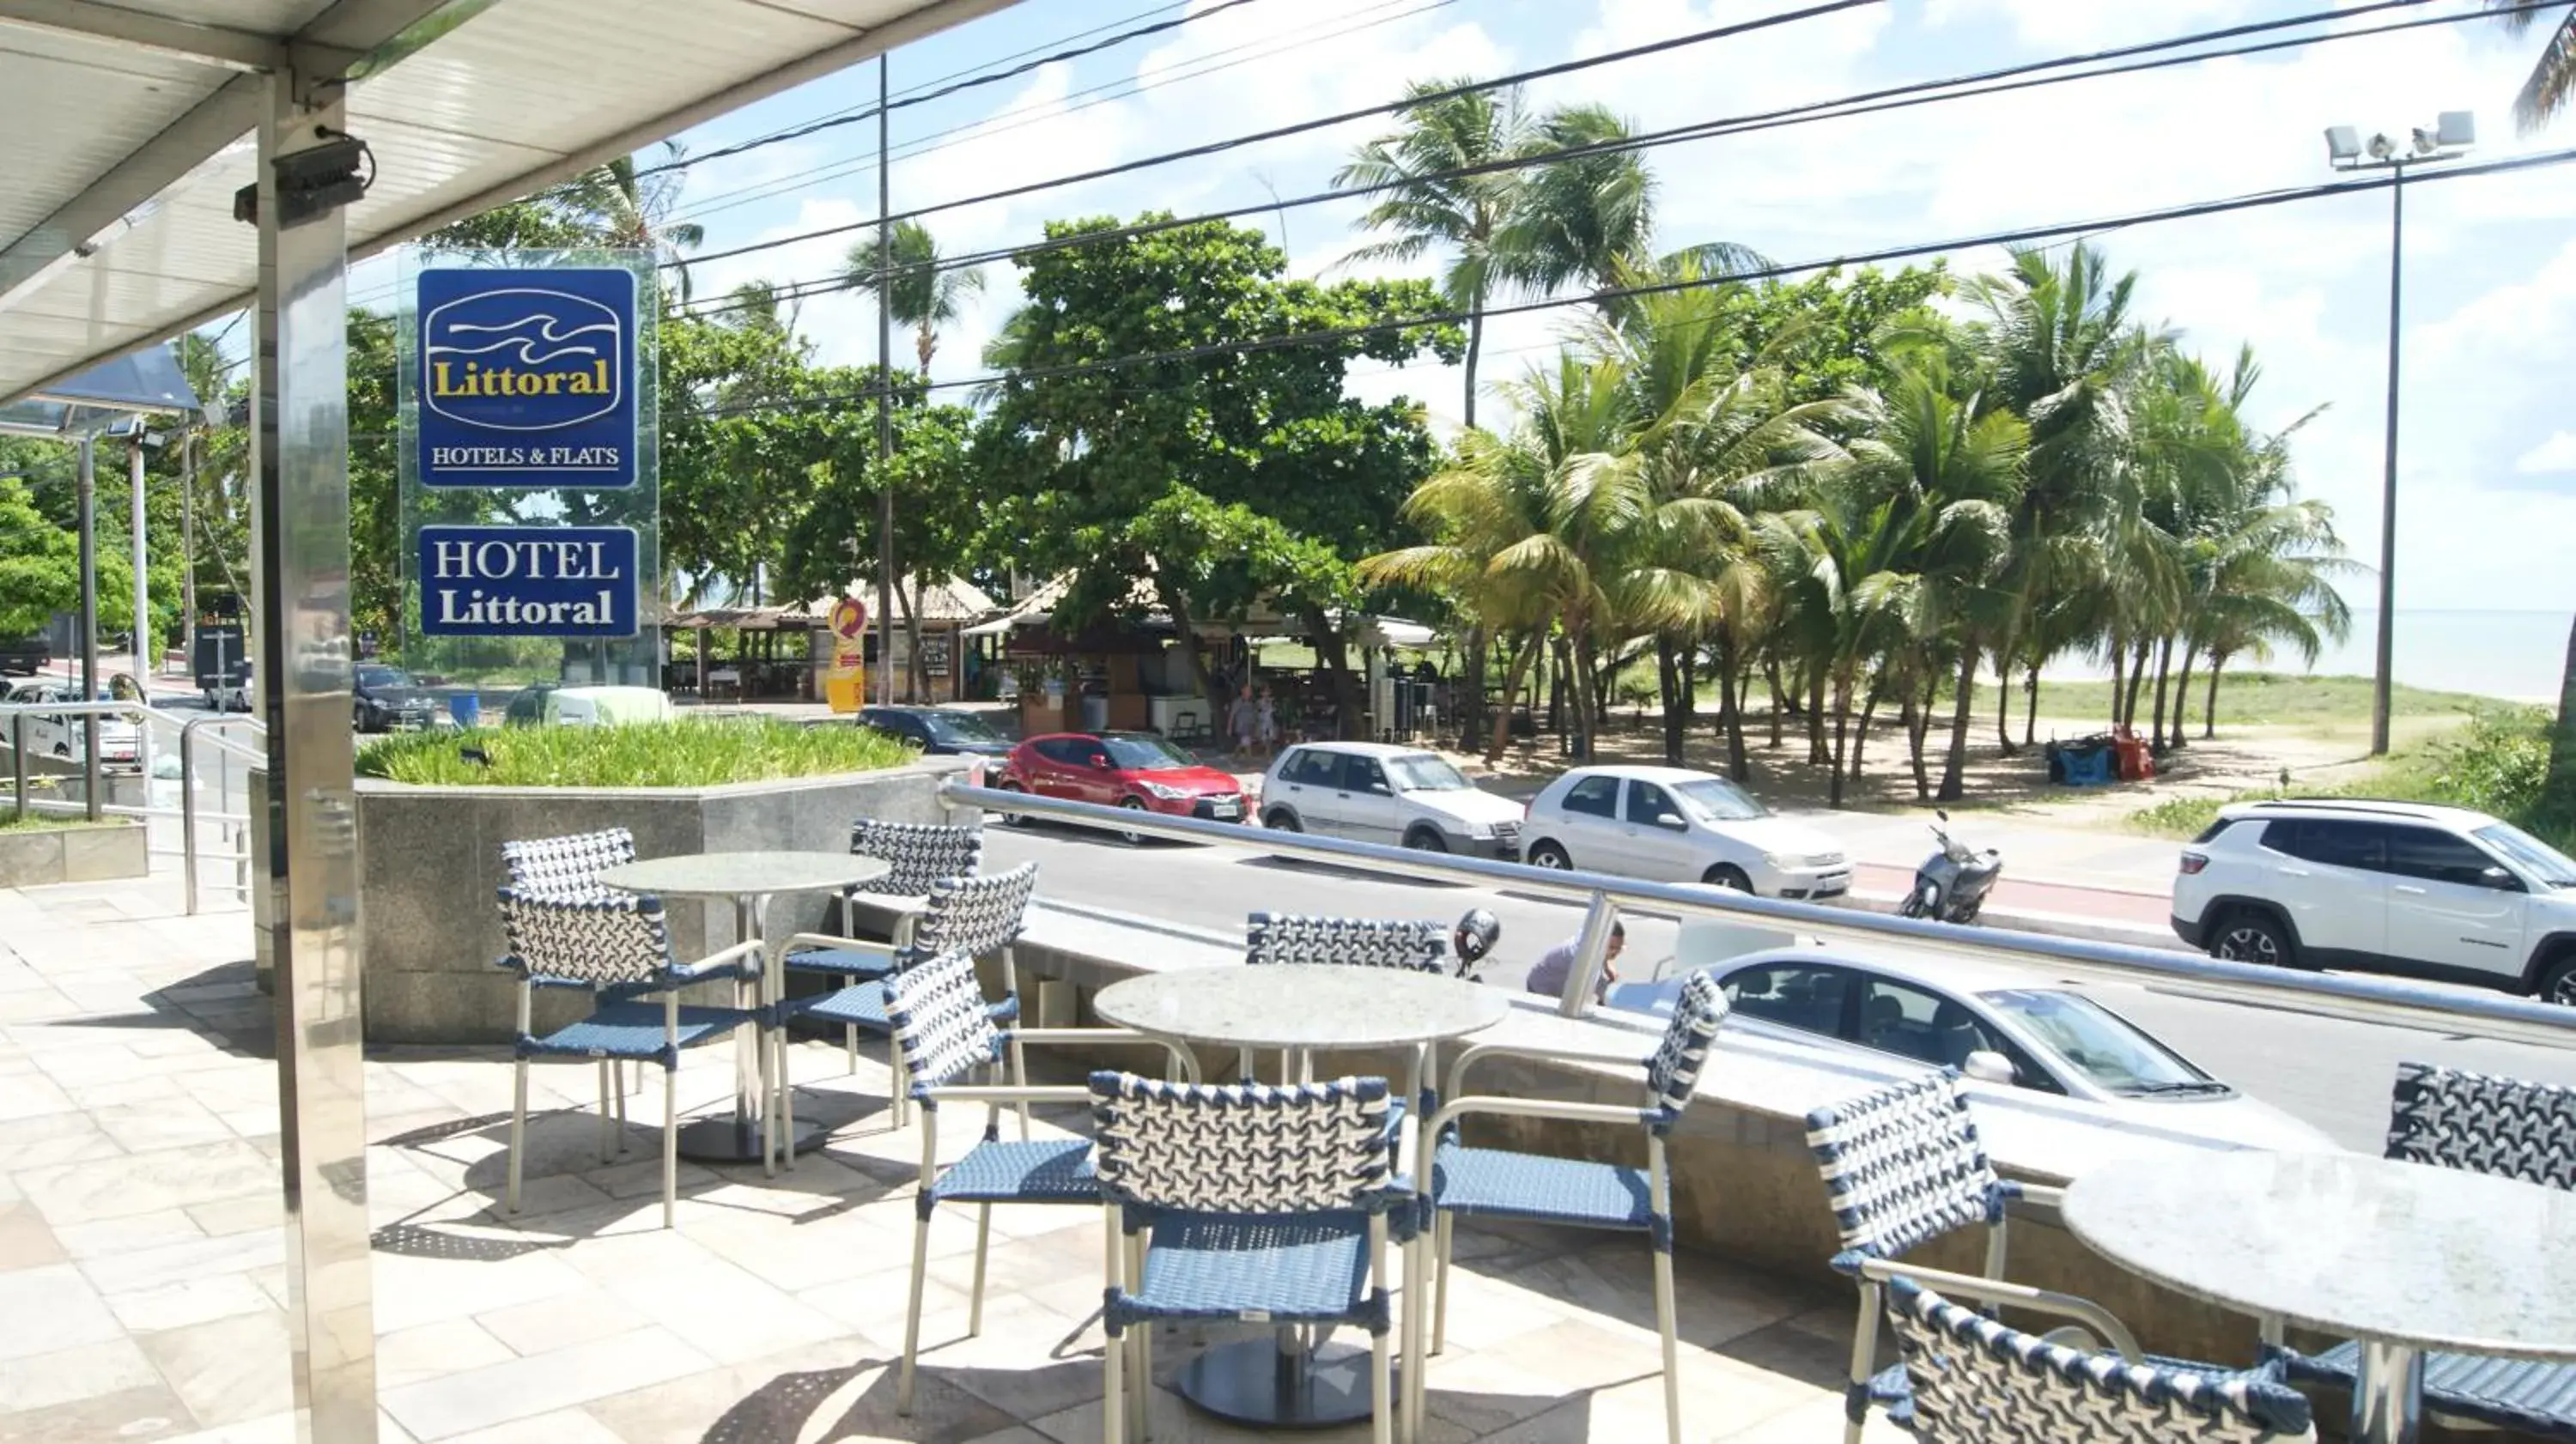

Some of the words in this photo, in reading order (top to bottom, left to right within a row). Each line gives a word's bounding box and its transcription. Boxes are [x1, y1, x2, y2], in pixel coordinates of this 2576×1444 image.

[434, 359, 610, 396] Littoral
[432, 447, 524, 464] HOTELS
[530, 447, 546, 464] &
[550, 447, 618, 464] FLATS
[434, 540, 619, 579] HOTEL
[439, 589, 614, 624] Littoral
